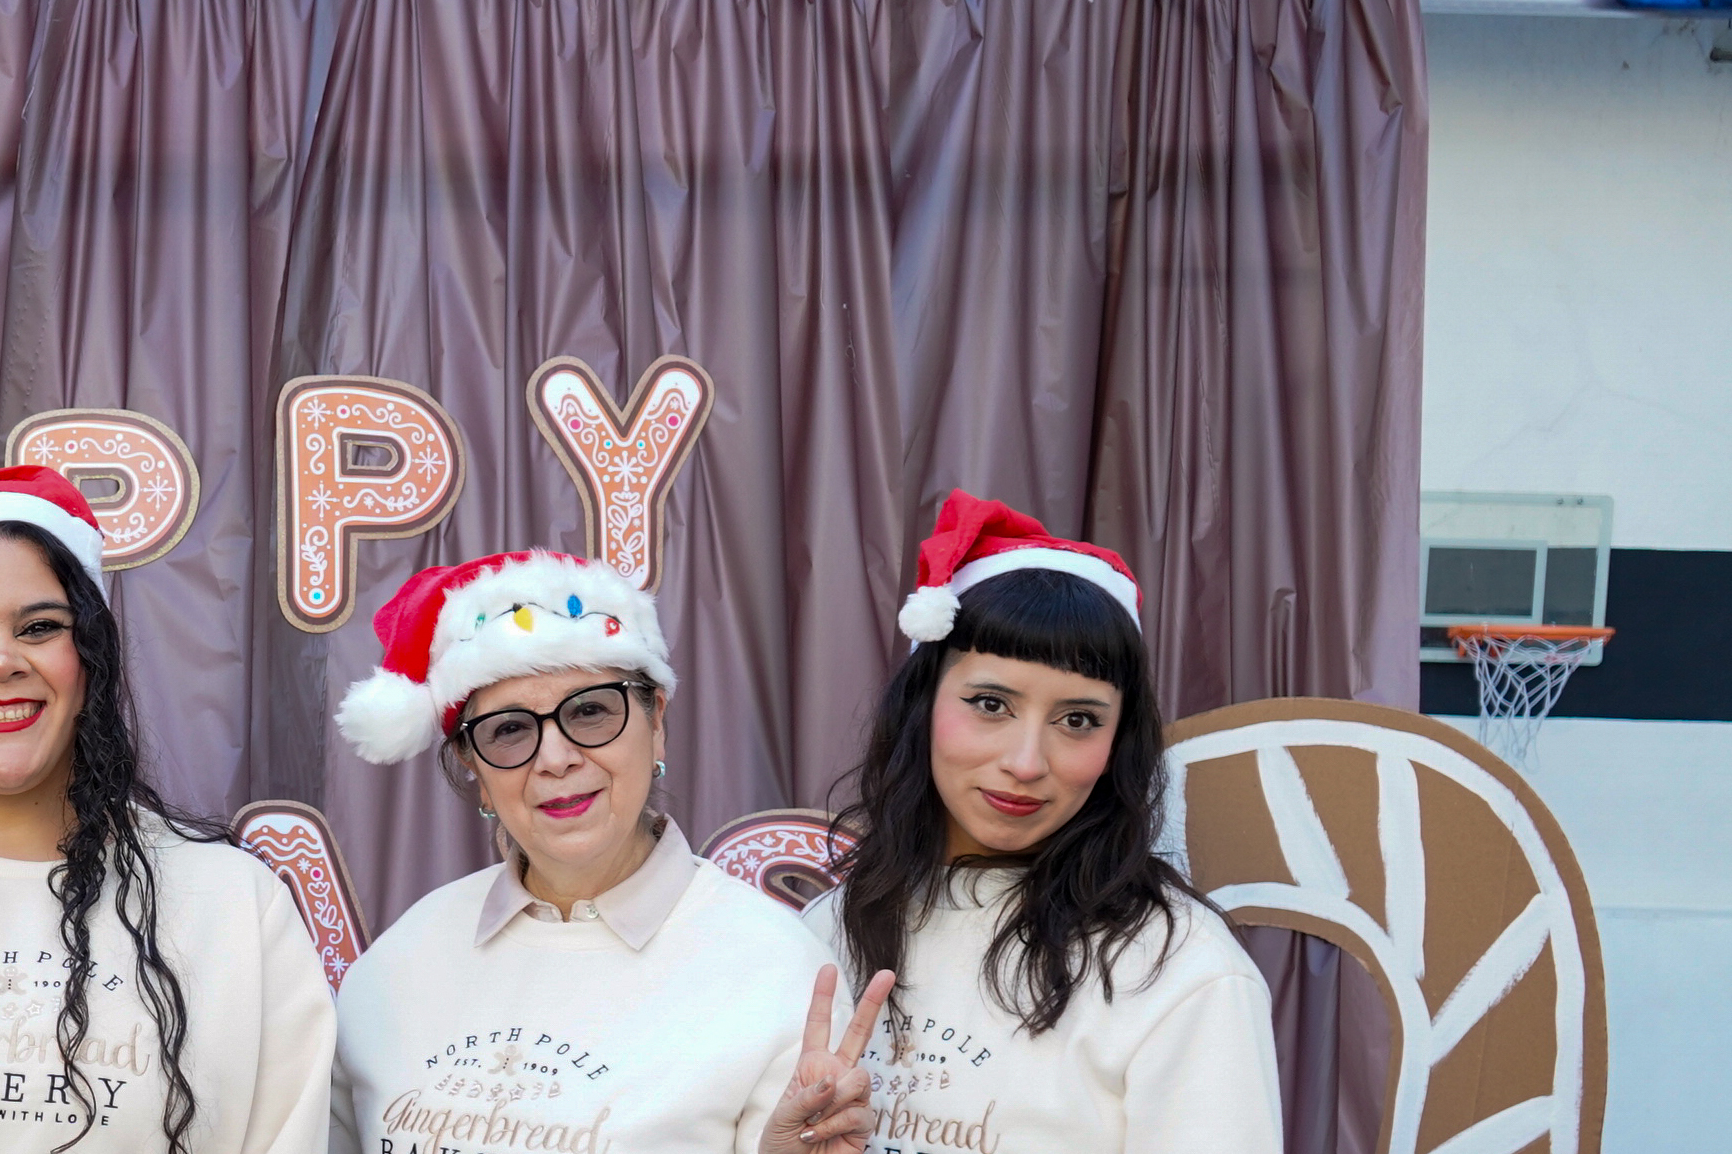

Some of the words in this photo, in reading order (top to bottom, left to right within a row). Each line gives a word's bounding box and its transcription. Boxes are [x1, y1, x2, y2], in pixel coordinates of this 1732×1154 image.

[33, 979, 70, 989] 190
[425, 1027, 523, 1069] NORTH
[534, 1033, 609, 1081] POLE
[923, 1018, 991, 1067] POLE
[454, 1057, 482, 1069] EST.
[523, 1062, 559, 1076] 1909
